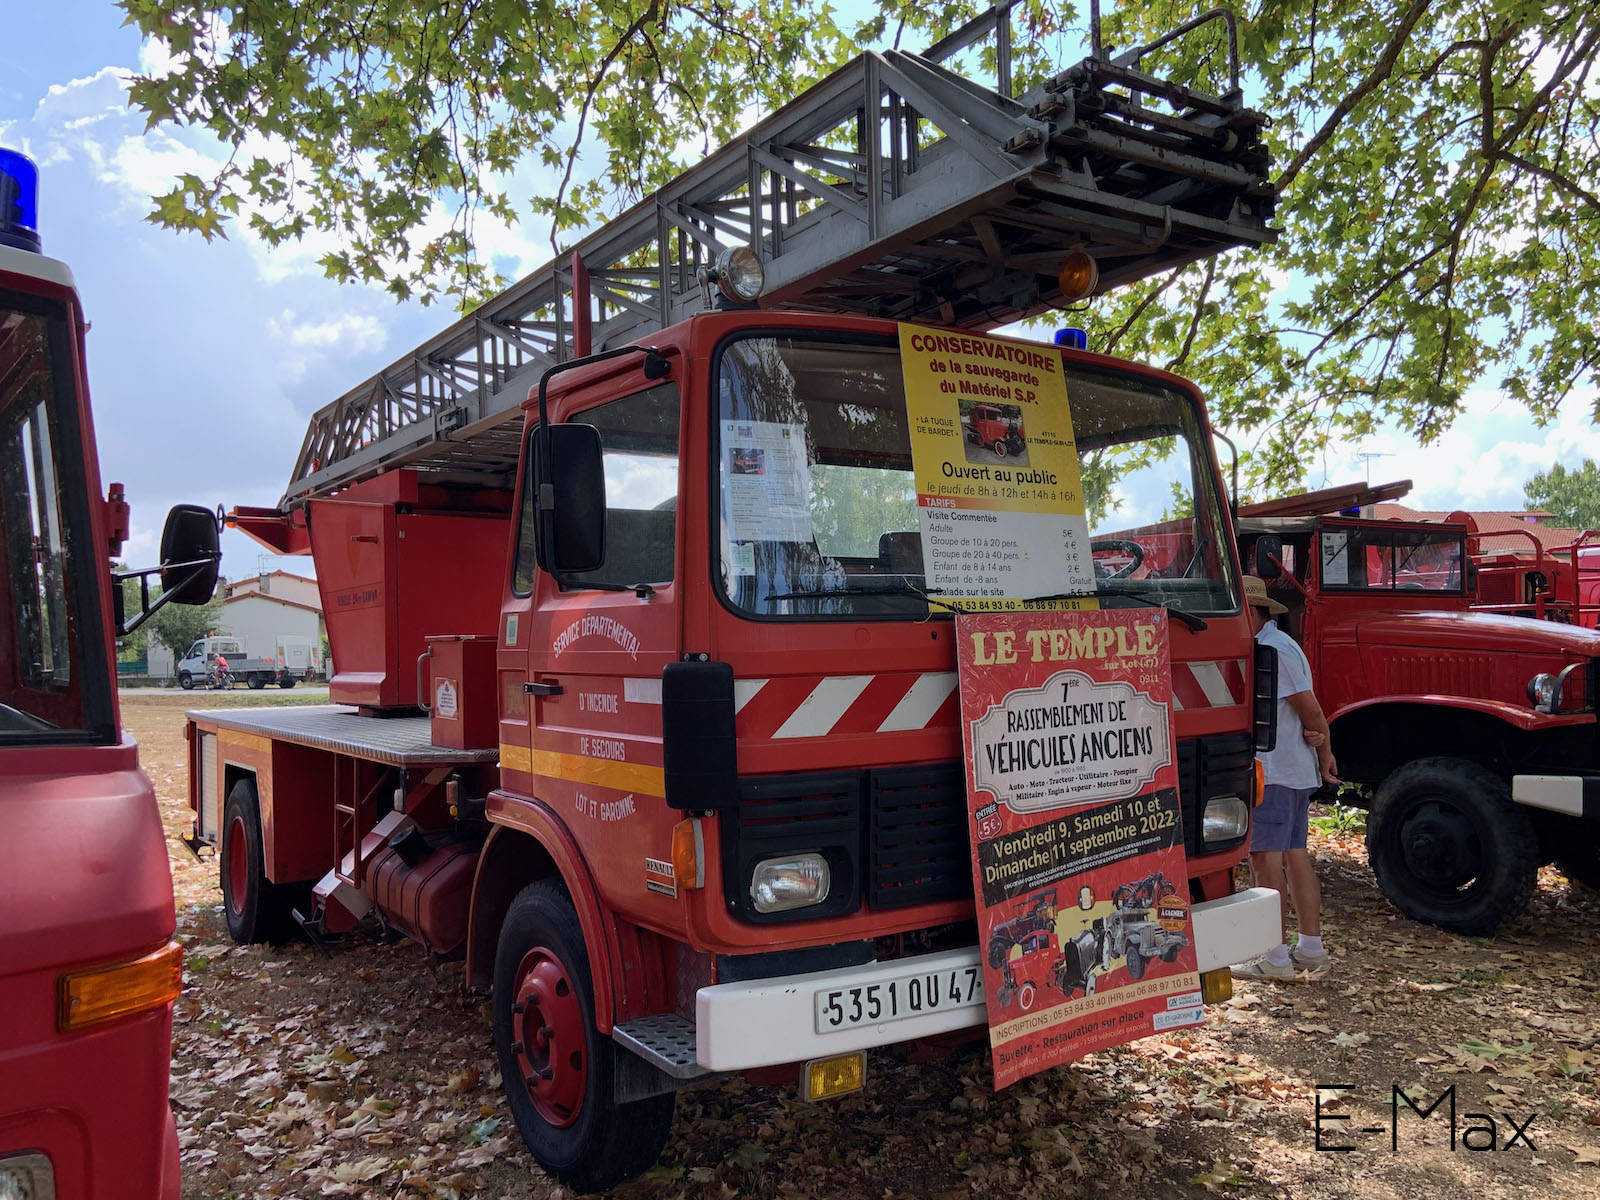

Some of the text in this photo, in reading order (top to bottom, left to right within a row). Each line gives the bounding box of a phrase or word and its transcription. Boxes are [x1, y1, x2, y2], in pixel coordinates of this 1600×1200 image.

[911, 334, 1056, 373] CONSERVATOIRE
[930, 358, 1040, 386] de la sauvegarde
[940, 380, 1039, 404] du Matériel S.P.
[916, 426, 954, 436] DE BARDET
[942, 462, 1058, 486] Ouvert au public
[928, 482, 1076, 502] le jeudi de 8h à 12h et 14h à 16h
[925, 498, 957, 509] TARIFS
[927, 511, 998, 523] Visite Commentée
[929, 523, 953, 533] Adulte
[930, 536, 1019, 550] Groupe de 10 à 20 pers.
[932, 549, 1020, 562] Groupe de 20 à 40 pers.
[934, 562, 958, 571] Enfant
[962, 562, 971, 571] de
[973, 563, 978, 571] 8
[980, 562, 985, 571] à
[987, 563, 996, 571] 14
[935, 575, 959, 584] Enfant
[963, 575, 973, 584] de
[975, 575, 984, 583] -8
[1069, 576, 1092, 585] Gratuit
[981, 587, 988, 596] le
[990, 588, 1004, 596] site
[966, 601, 976, 610] 53
[980, 601, 990, 610] 84
[992, 601, 1002, 610] 93
[1005, 601, 1015, 610] 40
[1024, 601, 1033, 610] 06
[1048, 601, 1057, 610] 97
[1061, 601, 1069, 610] 10
[1072, 601, 1080, 610] 81
[552, 613, 641, 662] SERVICE DÉPARTEMENTAL
[970, 624, 1159, 666] LE TEMPLE
[1104, 662, 1119, 670] sur
[1122, 660, 1139, 669] Lot
[579, 692, 618, 714] D'INCENDIE
[1008, 700, 1127, 733] RASSEMBLEMENT DE
[580, 737, 625, 761] DE SECOURS
[986, 726, 1152, 775] VÉHICULES ANCIENS
[1009, 767, 1138, 791] Auto Moto Tracteur Utilitaire Pompier
[1016, 792, 1044, 801] Militaire
[1048, 788, 1064, 797] Engin
[1071, 784, 1092, 794] vapeur
[1097, 780, 1118, 789] Moteur
[1120, 778, 1131, 787] fixe
[576, 792, 636, 822] LOT ET GARONNE
[976, 804, 997, 820] ENTRÉE
[983, 819, 996, 835] 5€
[994, 798, 1161, 858] Vendredi 9, Samedi 10 et
[986, 851, 1051, 883] Dimanche
[1052, 844, 1066, 861] 11
[1070, 824, 1137, 855] septembre
[1141, 811, 1175, 833] 2022
[646, 860, 674, 877] RENAULT
[828, 968, 978, 1026] 5351 QU 47
[996, 976, 1194, 1041] INSCRIPTIONS 05 53 84 93 40 (HR) ou 06 88 97 10 81
[1000, 1044, 1033, 1065] Buvette
[1043, 1022, 1099, 1048] Restauration
[1101, 1018, 1116, 1028] sur
[1119, 1008, 1145, 1025] place
